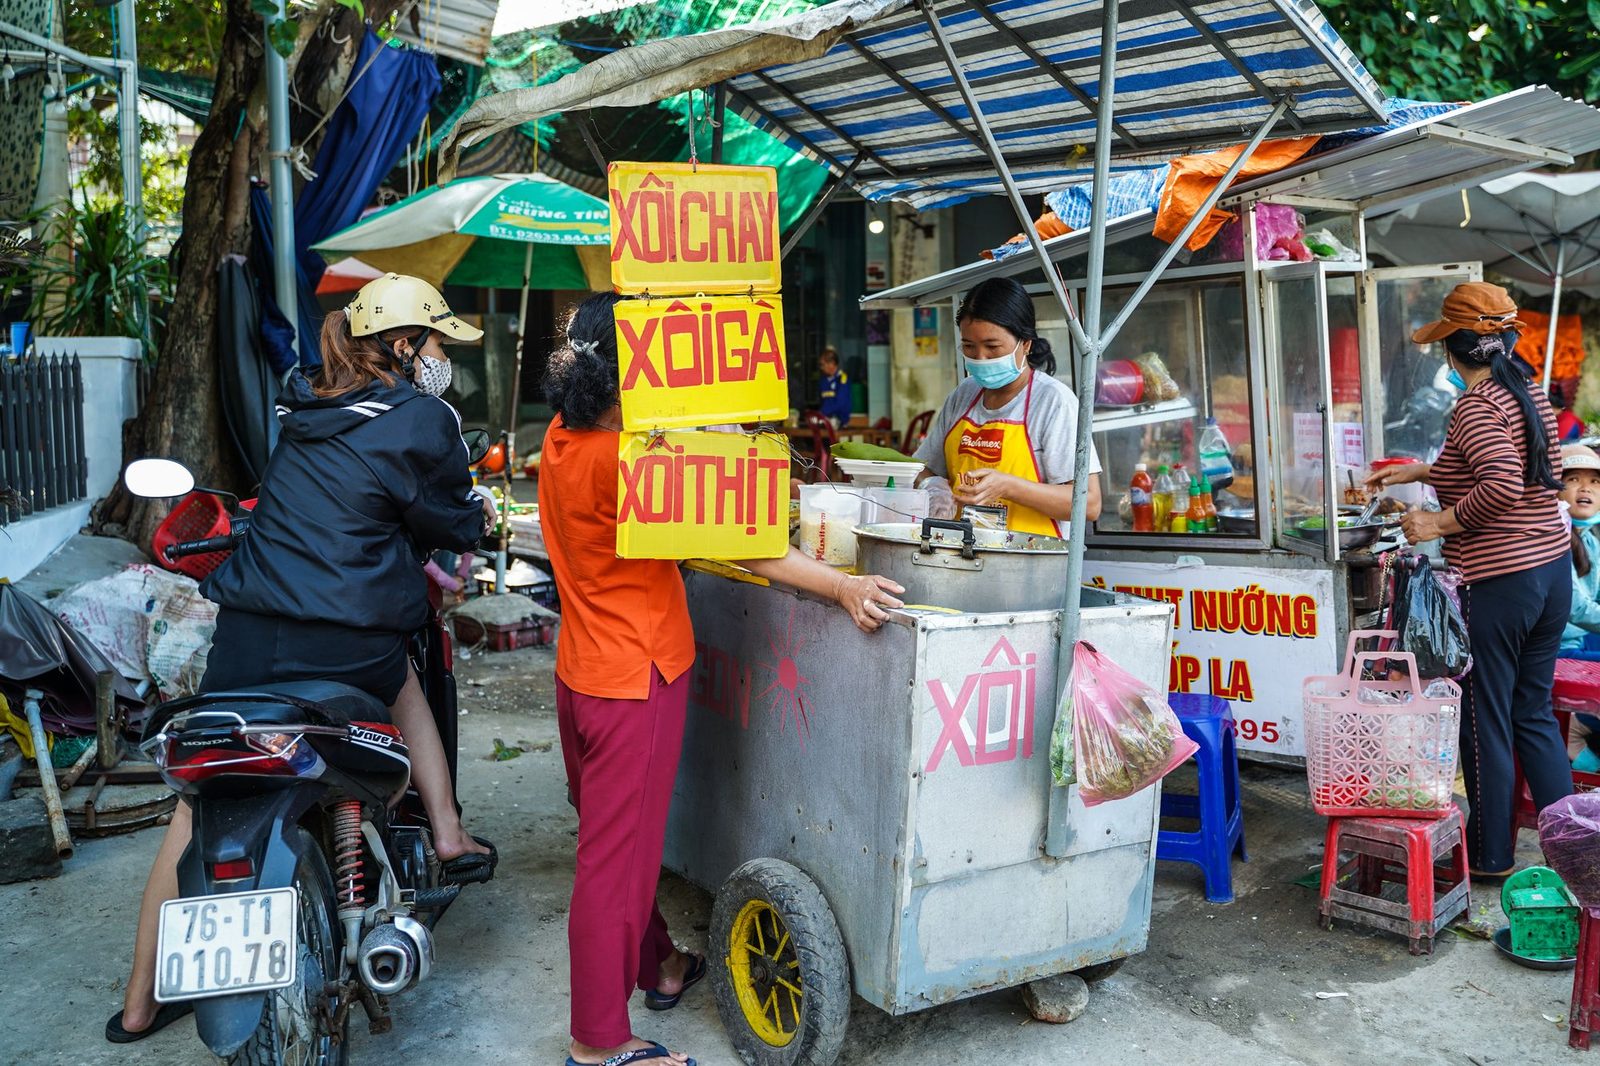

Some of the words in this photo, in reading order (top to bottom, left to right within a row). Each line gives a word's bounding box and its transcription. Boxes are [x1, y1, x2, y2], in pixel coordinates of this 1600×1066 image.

[497, 201, 567, 219] TRUNG
[680, 191, 778, 263] CHAY
[715, 300, 787, 383] GÀ
[1190, 584, 1318, 639] NƯỚNG
[1209, 657, 1256, 702] LA
[181, 737, 233, 747] HONDA
[182, 896, 273, 944] 76-T1
[166, 940, 287, 992] 010.78
